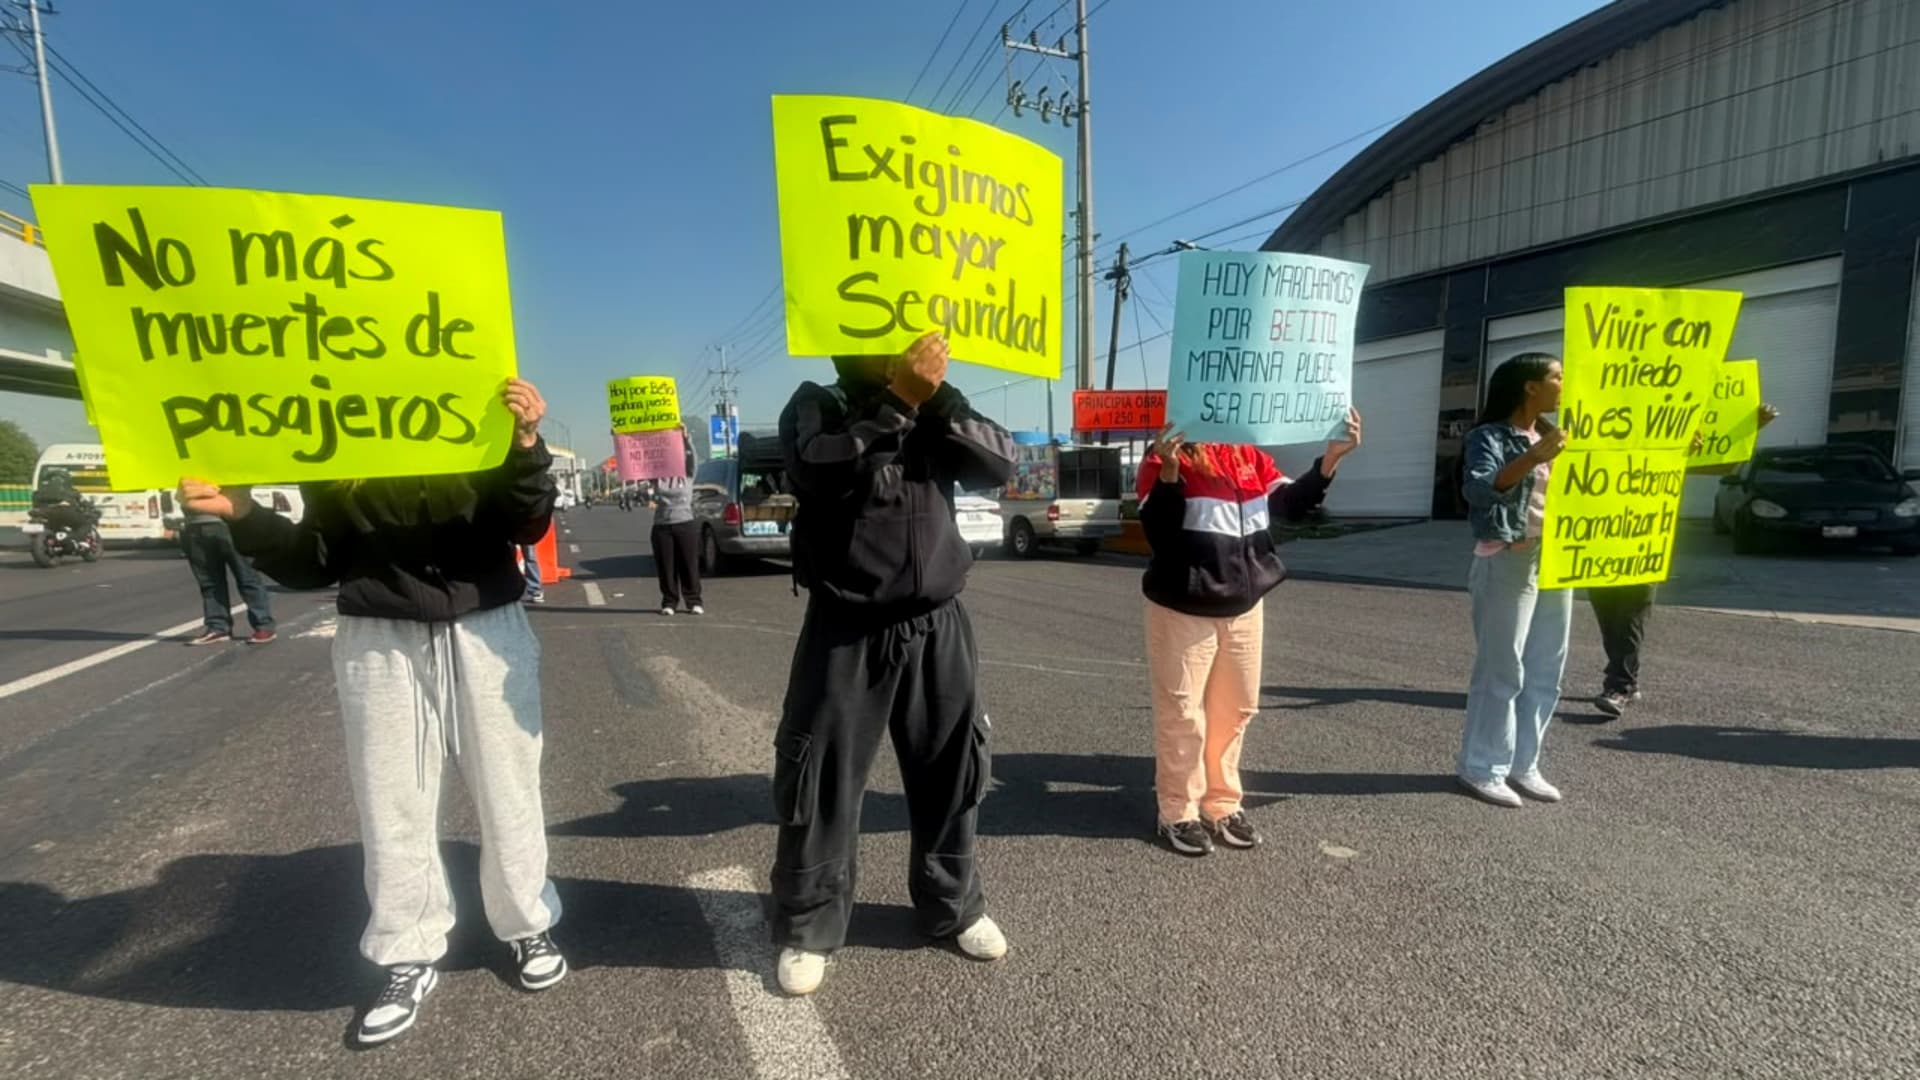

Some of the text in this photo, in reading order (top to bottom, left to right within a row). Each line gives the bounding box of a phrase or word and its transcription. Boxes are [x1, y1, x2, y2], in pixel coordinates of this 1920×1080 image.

[820, 114, 1033, 226] Exigimos
[93, 207, 395, 291] No más
[847, 212, 1006, 280] mayor
[1203, 262, 1354, 304] HOY MARCHAMOS
[131, 290, 477, 362] muertes de
[837, 271, 1047, 357] Seguridad
[1208, 307, 1337, 344] POR BETITO
[1584, 302, 1712, 351] Vivir con
[1187, 347, 1336, 383] MAÑANA PUEDE
[1600, 355, 1682, 390] miedo
[609, 383, 627, 399] Hoy
[630, 385, 648, 399] por
[1077, 395, 1164, 408] PRINCIPIA OBRA
[1201, 392, 1241, 424] SER
[161, 374, 477, 463] pasajeros
[1093, 413, 1100, 424] A
[1563, 392, 1700, 440] No es vivir
[1564, 452, 1681, 497] No debemos
[1555, 501, 1674, 541] normalizar la
[1557, 537, 1667, 584] Inseguridad
